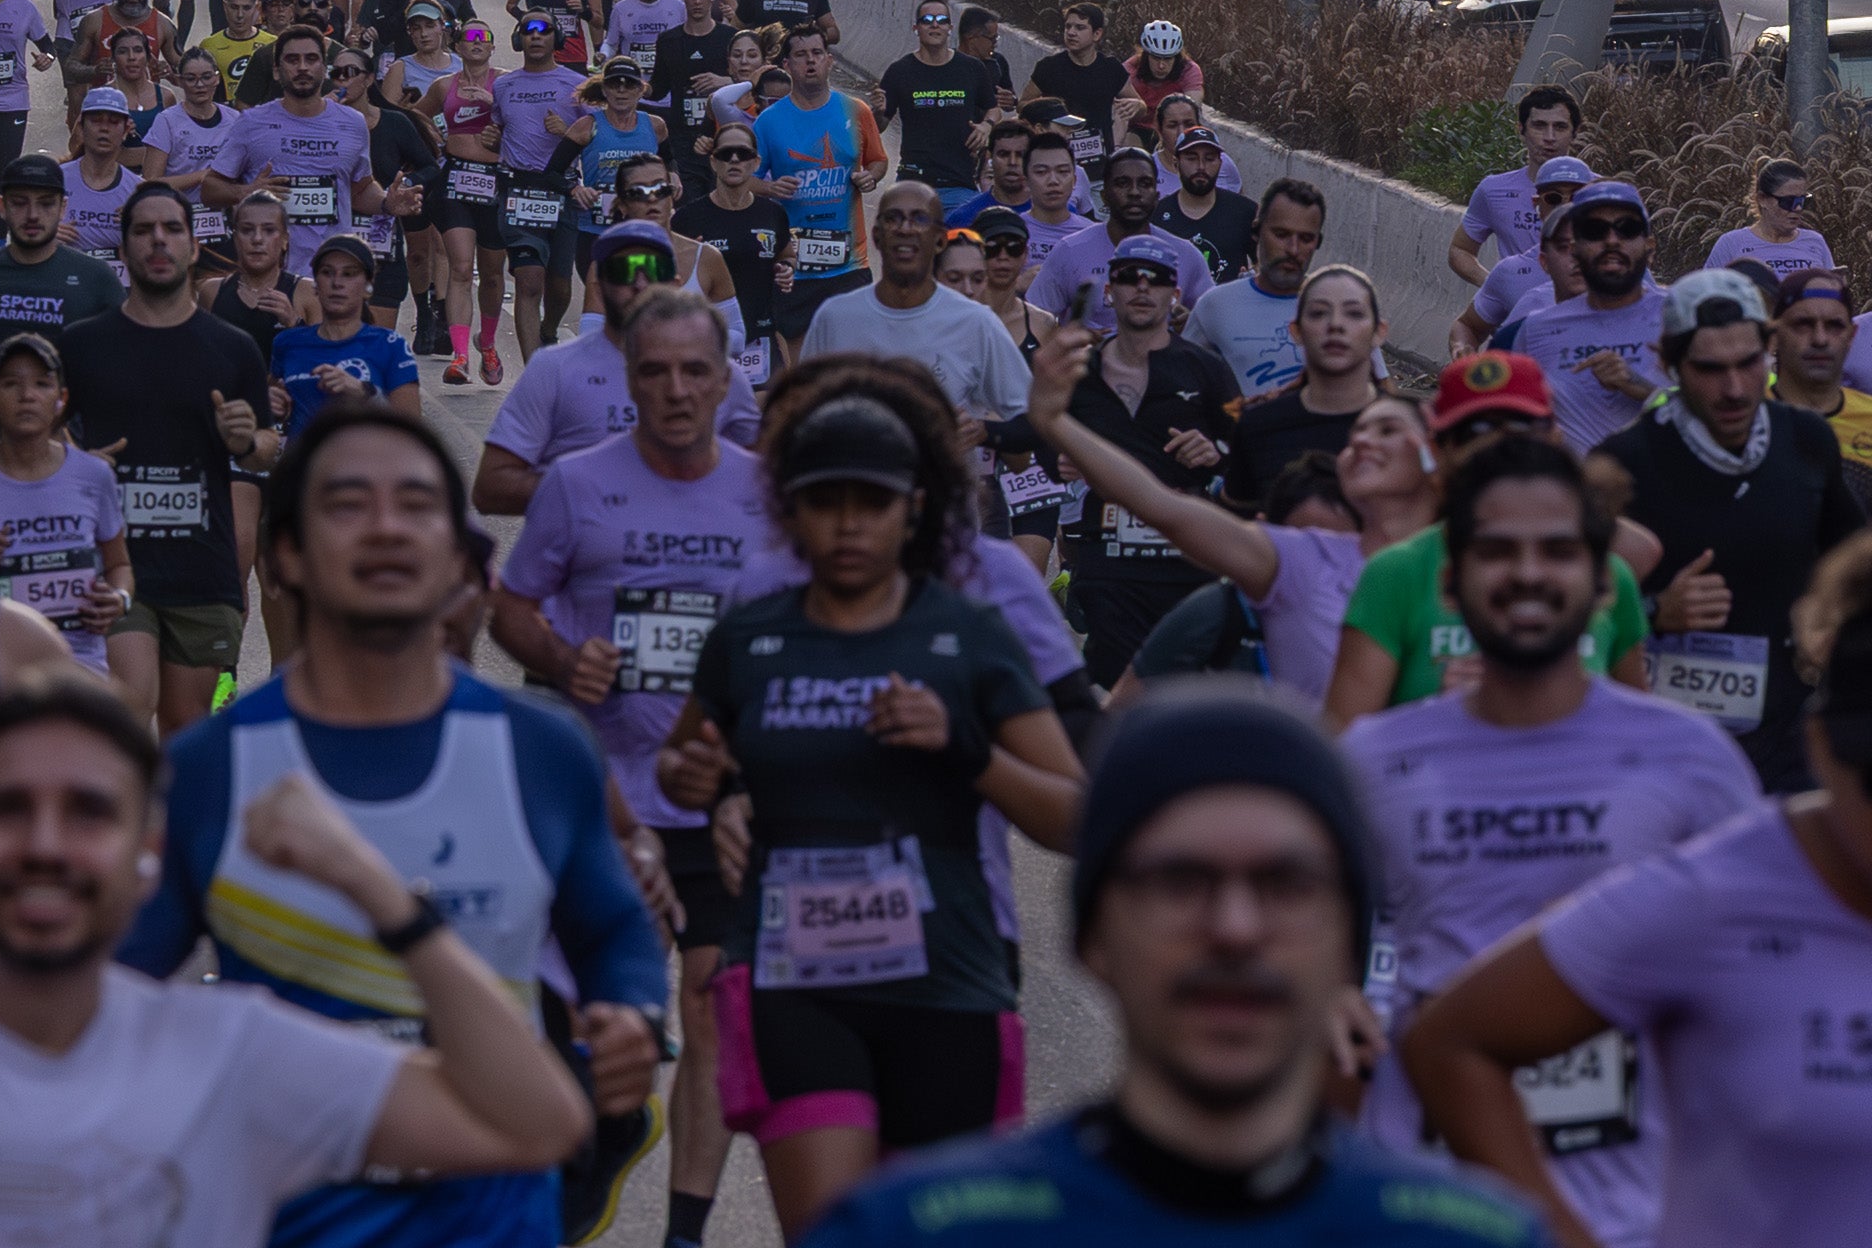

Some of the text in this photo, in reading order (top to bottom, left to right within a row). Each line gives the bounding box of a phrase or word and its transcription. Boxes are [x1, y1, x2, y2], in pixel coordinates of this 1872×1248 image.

[291, 138, 339, 150] SPCITY
[796, 165, 852, 189] SPCITY
[293, 192, 328, 206] 7583
[520, 202, 557, 215] 14299
[806, 242, 841, 256] 17145
[0, 294, 64, 313] SPCITY
[132, 492, 198, 510] 10403
[1, 515, 83, 536] SPCITY
[642, 531, 744, 557] SPCITY
[27, 579, 85, 602] 5476
[1669, 663, 1759, 698] 25703
[1442, 802, 1608, 844] SPCITY
[797, 887, 909, 928] 25448
